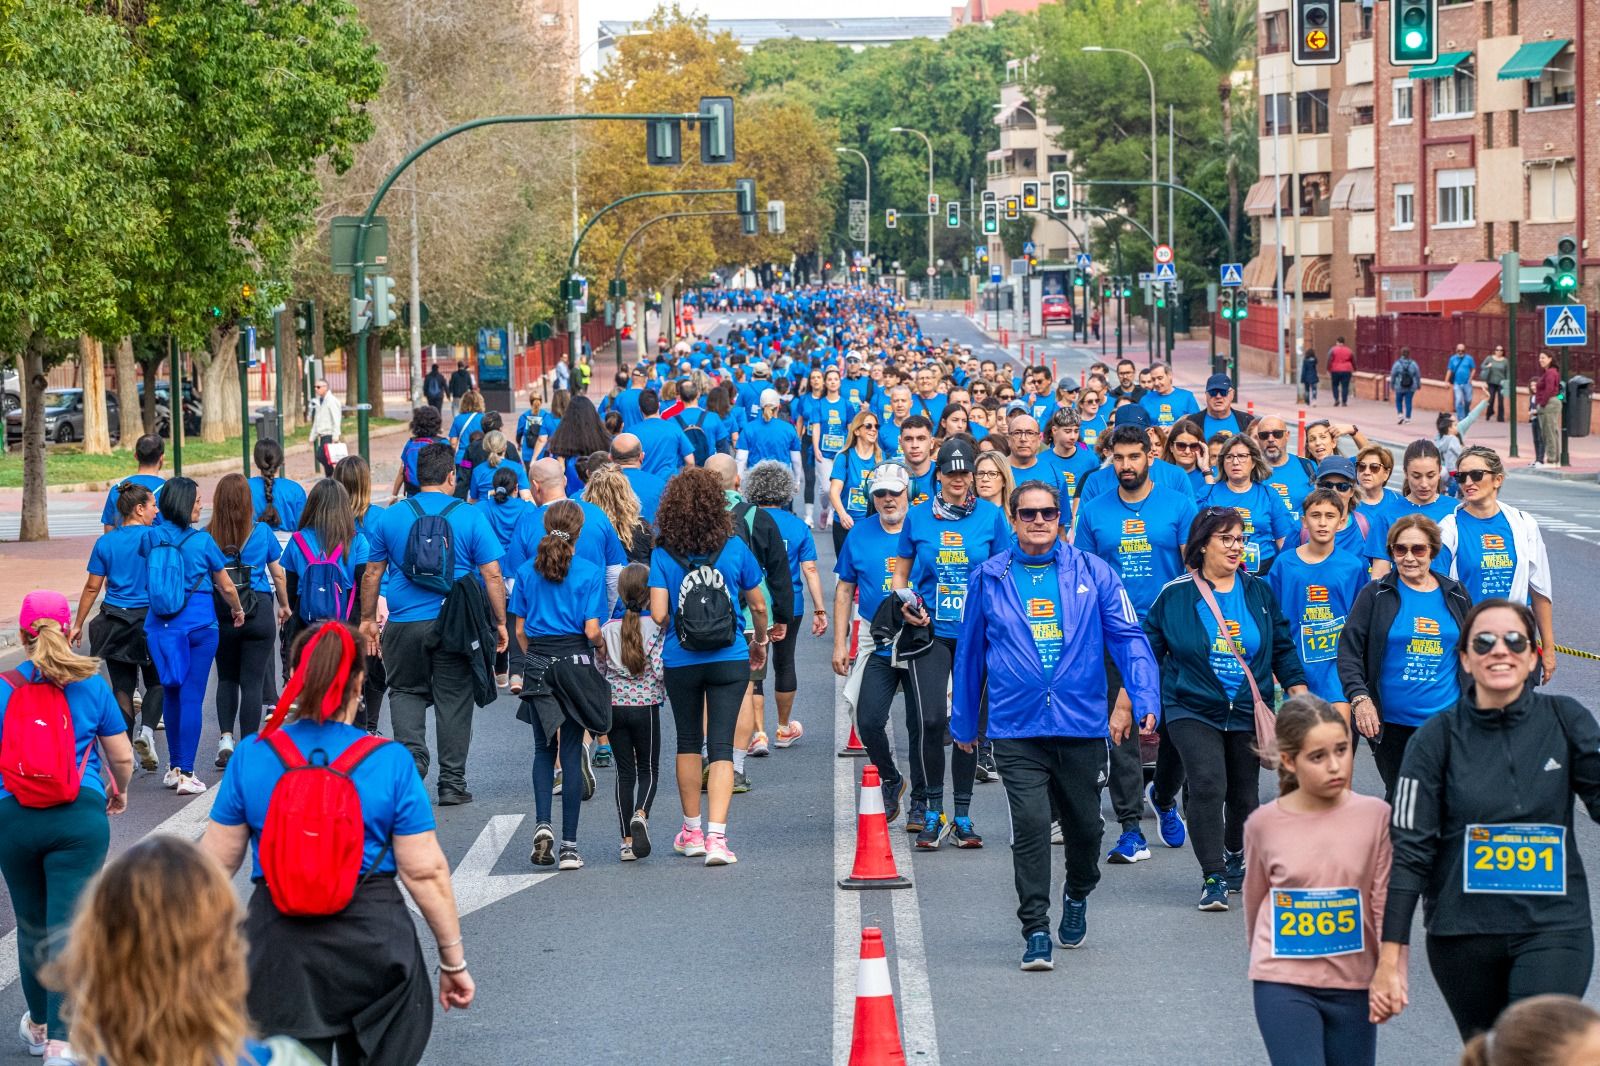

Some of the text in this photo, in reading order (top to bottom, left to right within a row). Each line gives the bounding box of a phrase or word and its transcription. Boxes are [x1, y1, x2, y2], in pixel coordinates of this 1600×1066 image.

[852, 494, 868, 504] 26
[700, 565, 723, 588] DO
[941, 596, 962, 609] 40
[1308, 632, 1341, 650] 127
[1474, 846, 1553, 871] 2991
[1280, 910, 1356, 937] 2865
